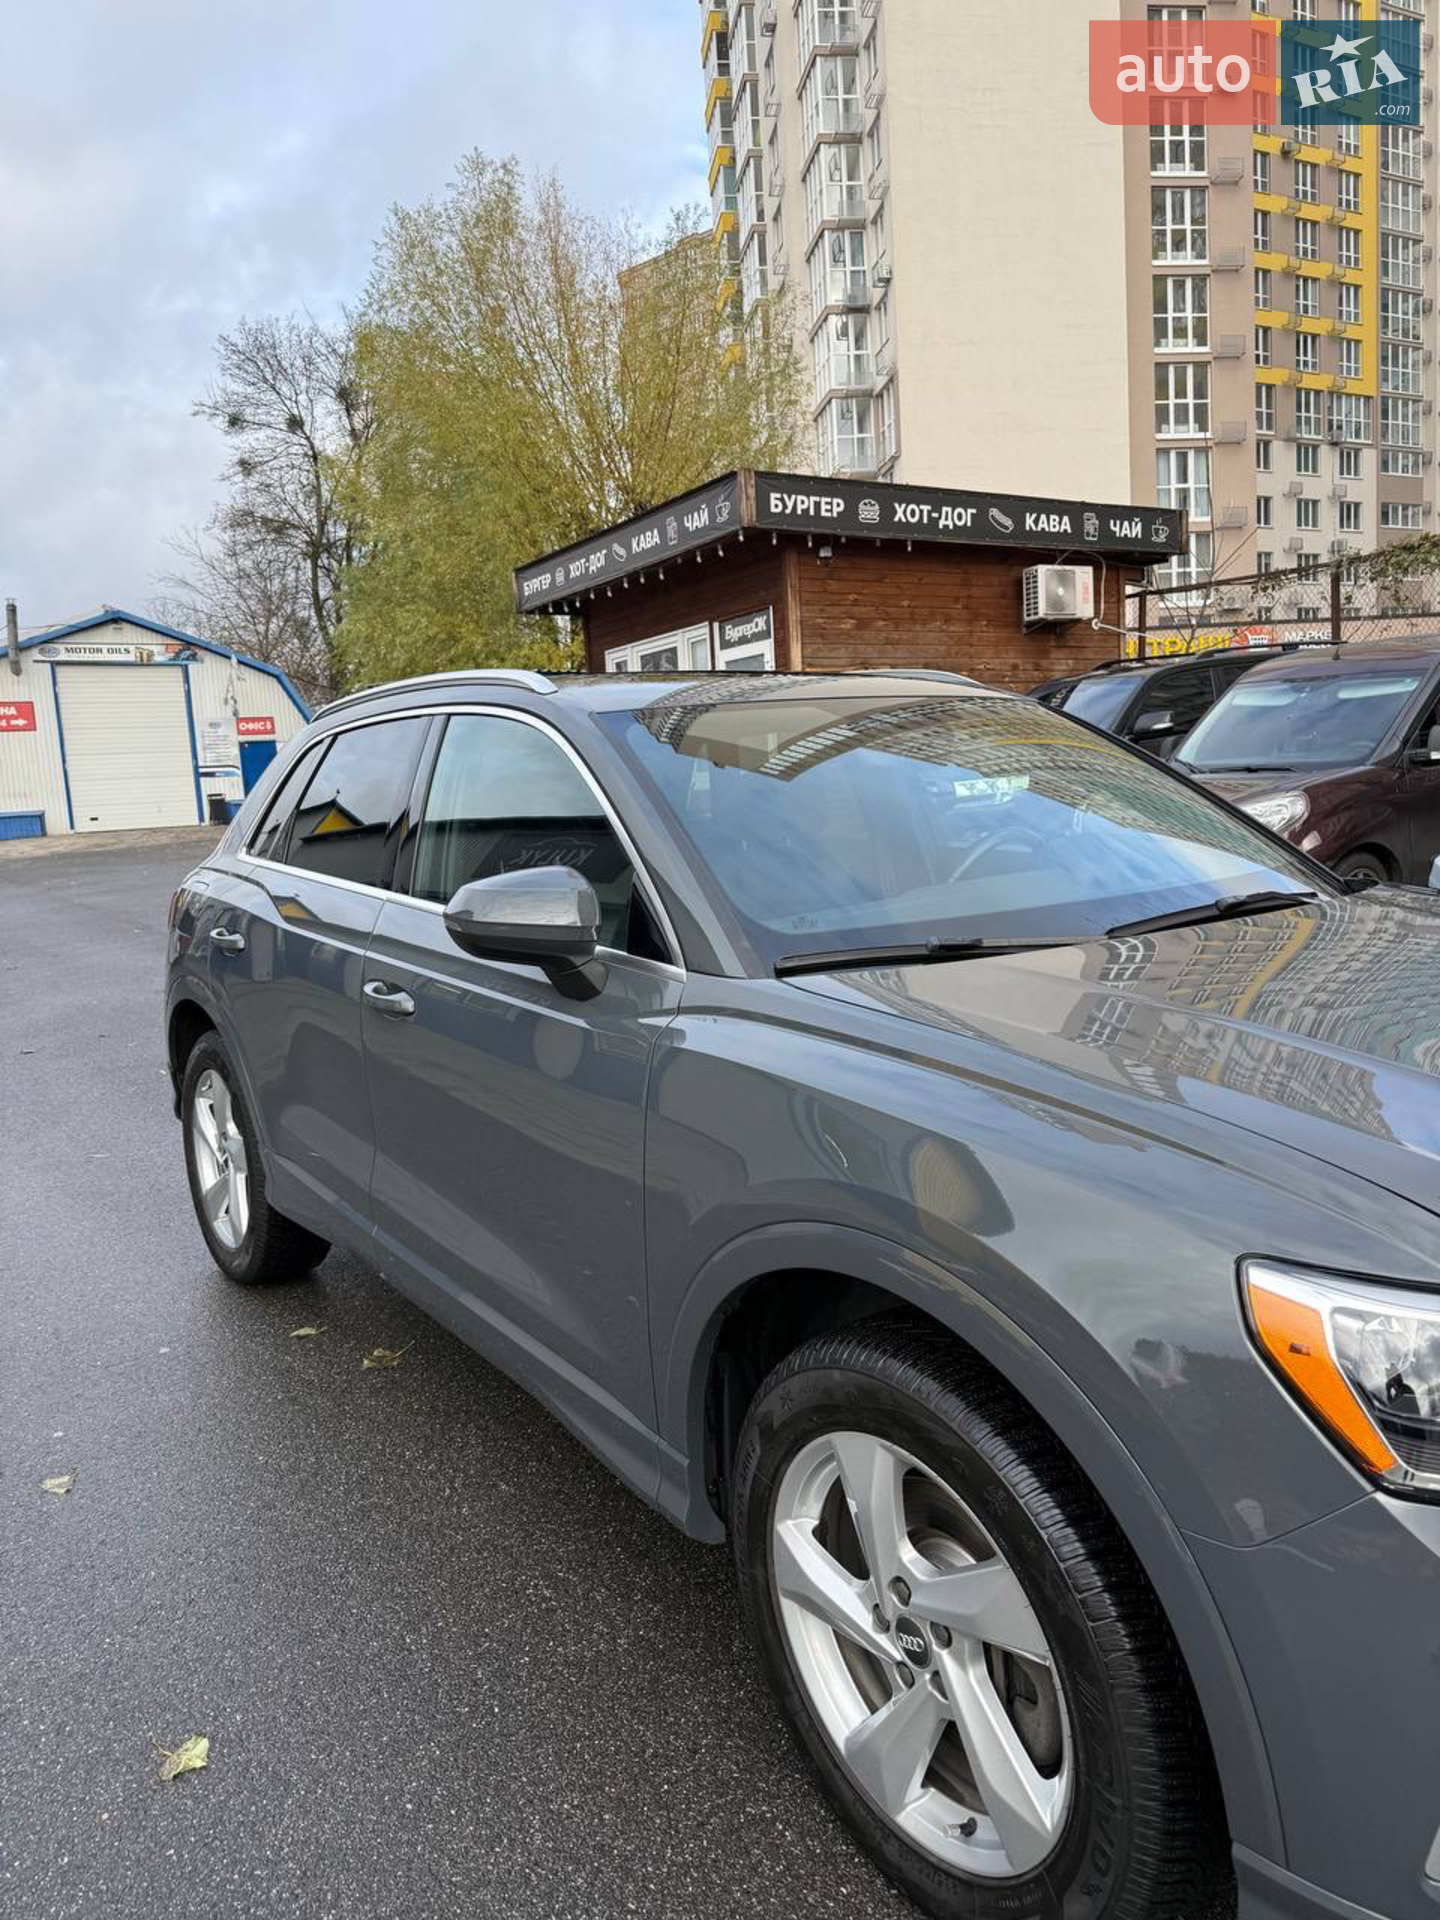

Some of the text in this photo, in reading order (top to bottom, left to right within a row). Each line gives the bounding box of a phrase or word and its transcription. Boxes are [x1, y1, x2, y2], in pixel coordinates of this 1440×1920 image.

[769, 492, 1142, 539] БУРГЕР ХОТ-ДОГ КАВА ЧАЙ
[523, 503, 709, 597] БУРГЕР ХОТ-ДОГ КАВА ЧАЙ
[1283, 629, 1334, 643] МАРКЕ
[64, 646, 103, 655] MOTOR
[106, 646, 131, 655] OILS
[239, 721, 265, 731] ОФІС
